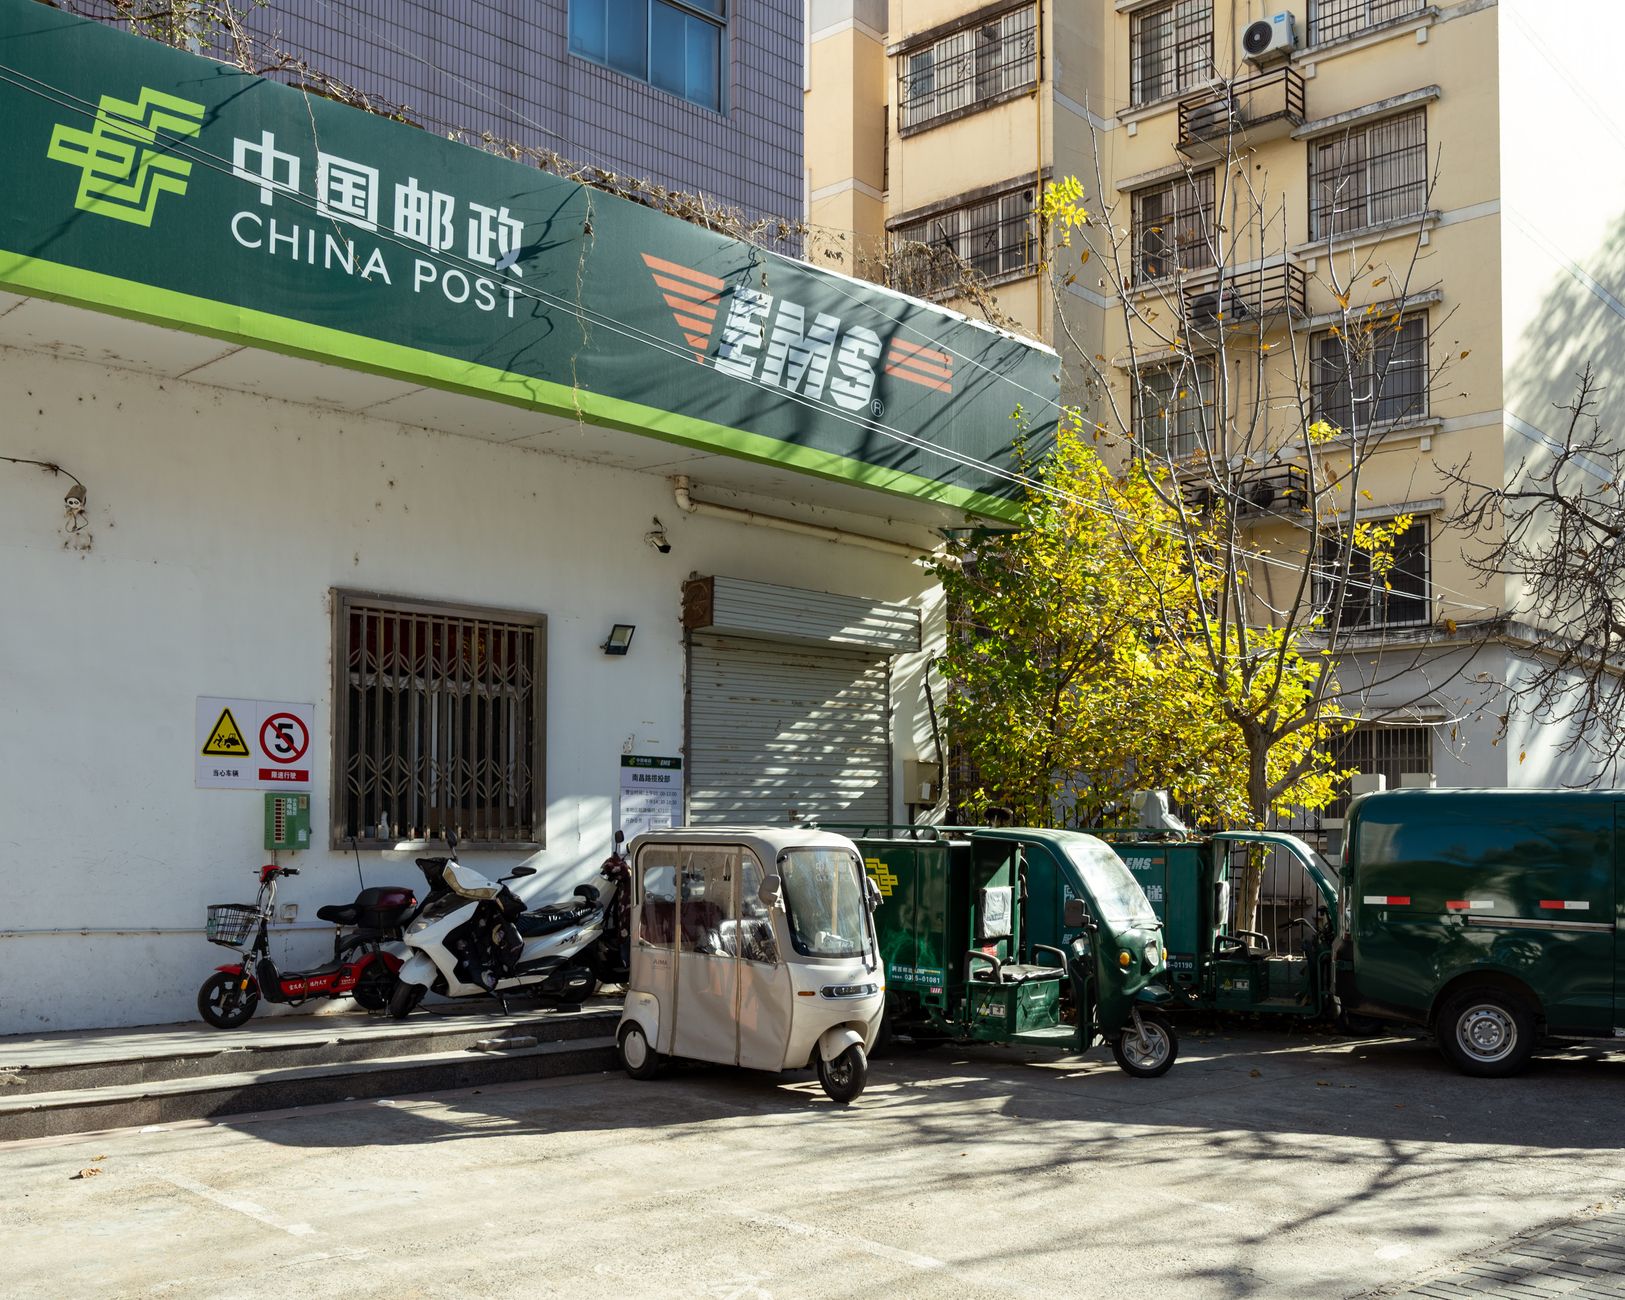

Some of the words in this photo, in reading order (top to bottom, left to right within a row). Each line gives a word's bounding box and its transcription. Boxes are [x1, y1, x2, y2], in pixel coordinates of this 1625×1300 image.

[231, 130, 525, 278] 中国邮政
[231, 210, 392, 286] CHINA
[413, 258, 524, 319] POST
[713, 284, 885, 412] EMS
[213, 769, 239, 777] 当心车辆
[271, 771, 297, 780] 限速行驶
[1125, 857, 1152, 870] EMS
